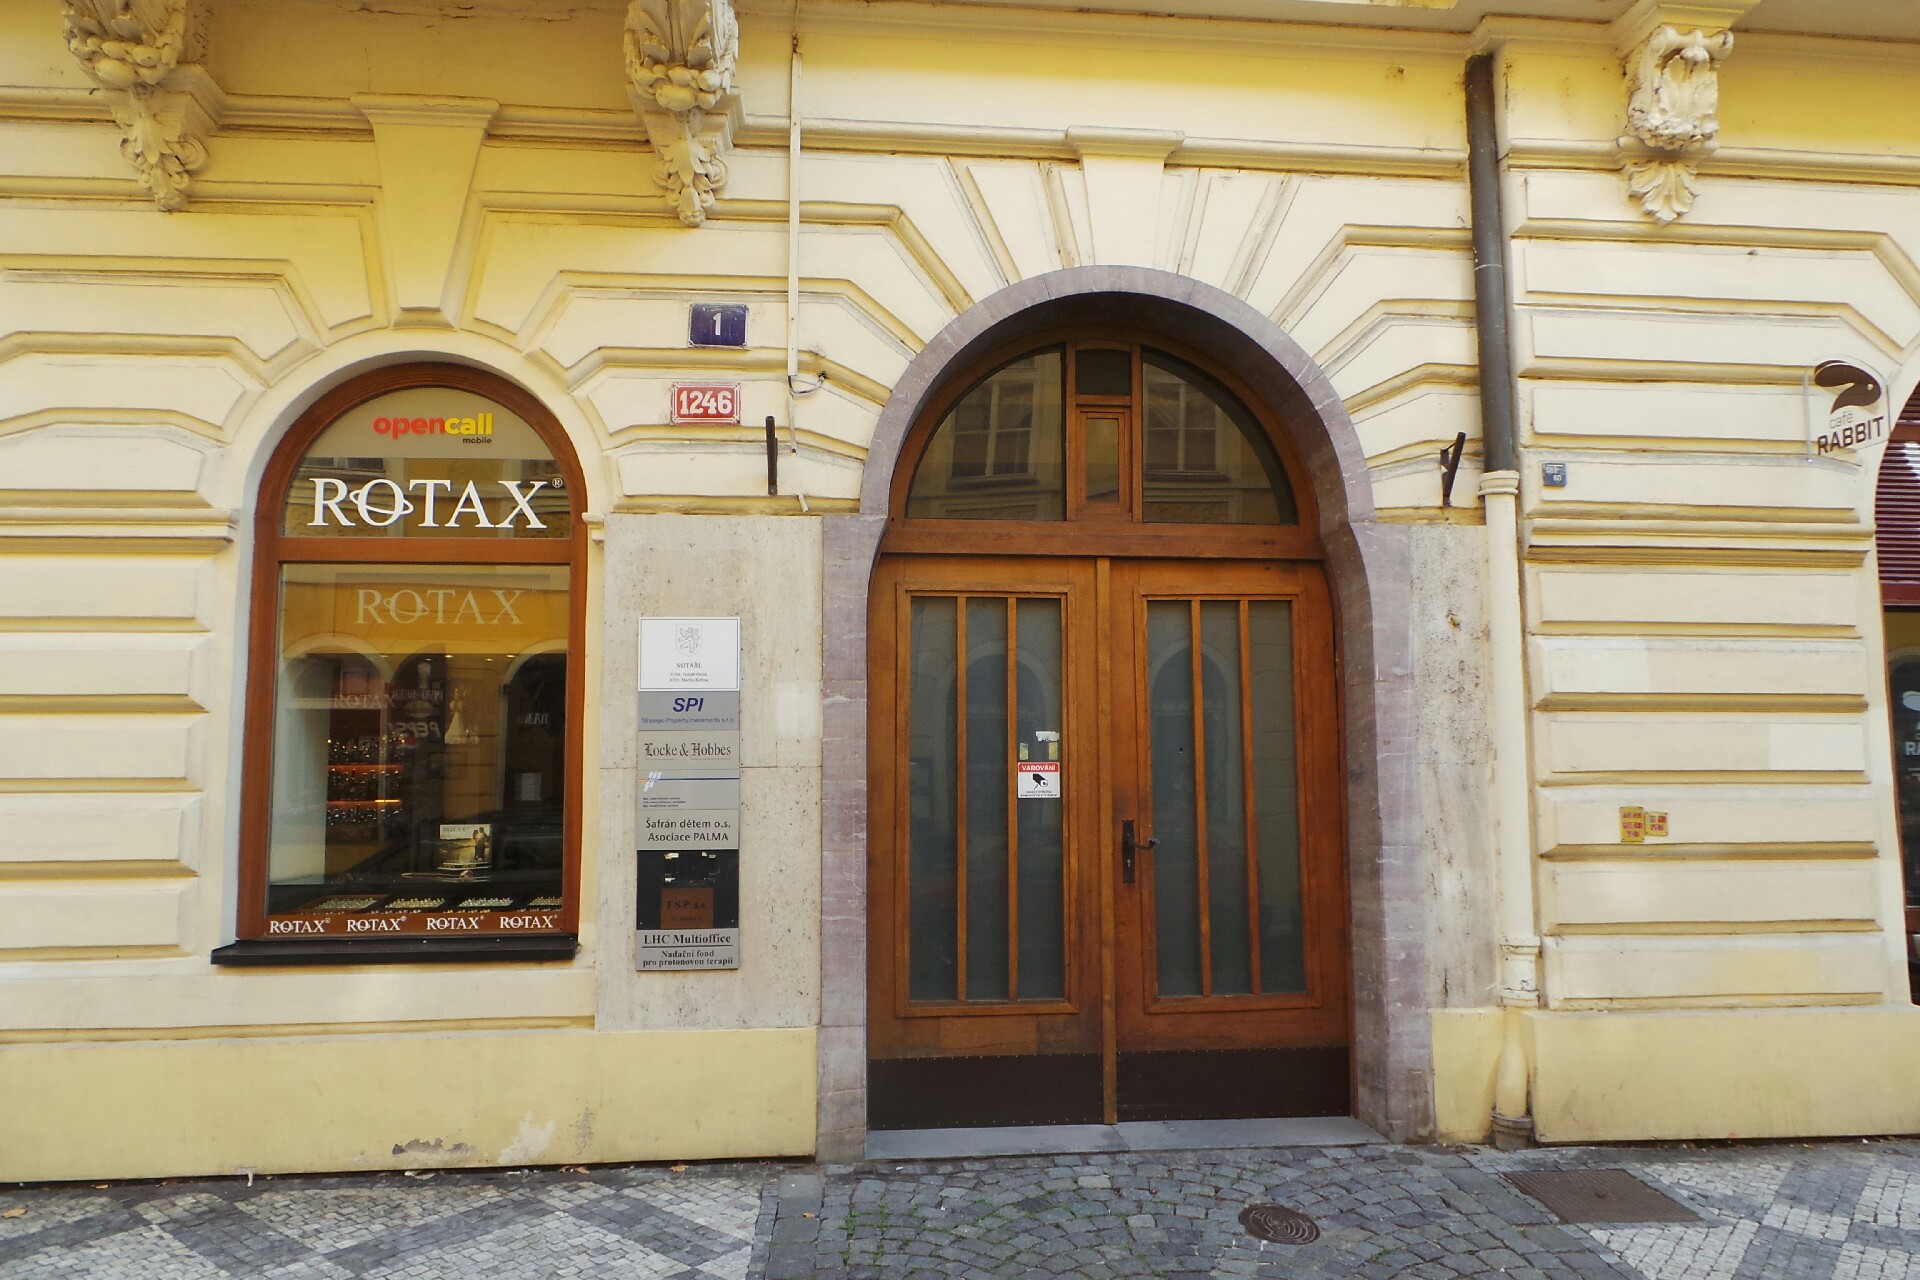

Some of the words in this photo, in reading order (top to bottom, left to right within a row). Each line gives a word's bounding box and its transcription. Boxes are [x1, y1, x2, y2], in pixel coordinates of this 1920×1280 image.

[713, 313, 721, 335] 1
[680, 391, 732, 415] 1246
[372, 413, 493, 440] opencall
[1818, 416, 1883, 455] RABBIT
[673, 698, 704, 712] SPI
[645, 743, 677, 756] Locke
[680, 743, 688, 756] &
[691, 742, 731, 756] Hobbes
[646, 818, 676, 828] Šafrán
[680, 818, 710, 828] dětem
[714, 820, 730, 828] o.s.
[648, 832, 690, 841] Asociace
[694, 832, 728, 840] PALMA
[644, 934, 670, 944] LHC
[673, 934, 730, 944] Multioffice
[662, 950, 694, 958] Nadační
[642, 960, 656, 968] pro
[659, 959, 704, 967] protonovou
[706, 958, 733, 966] terapii
